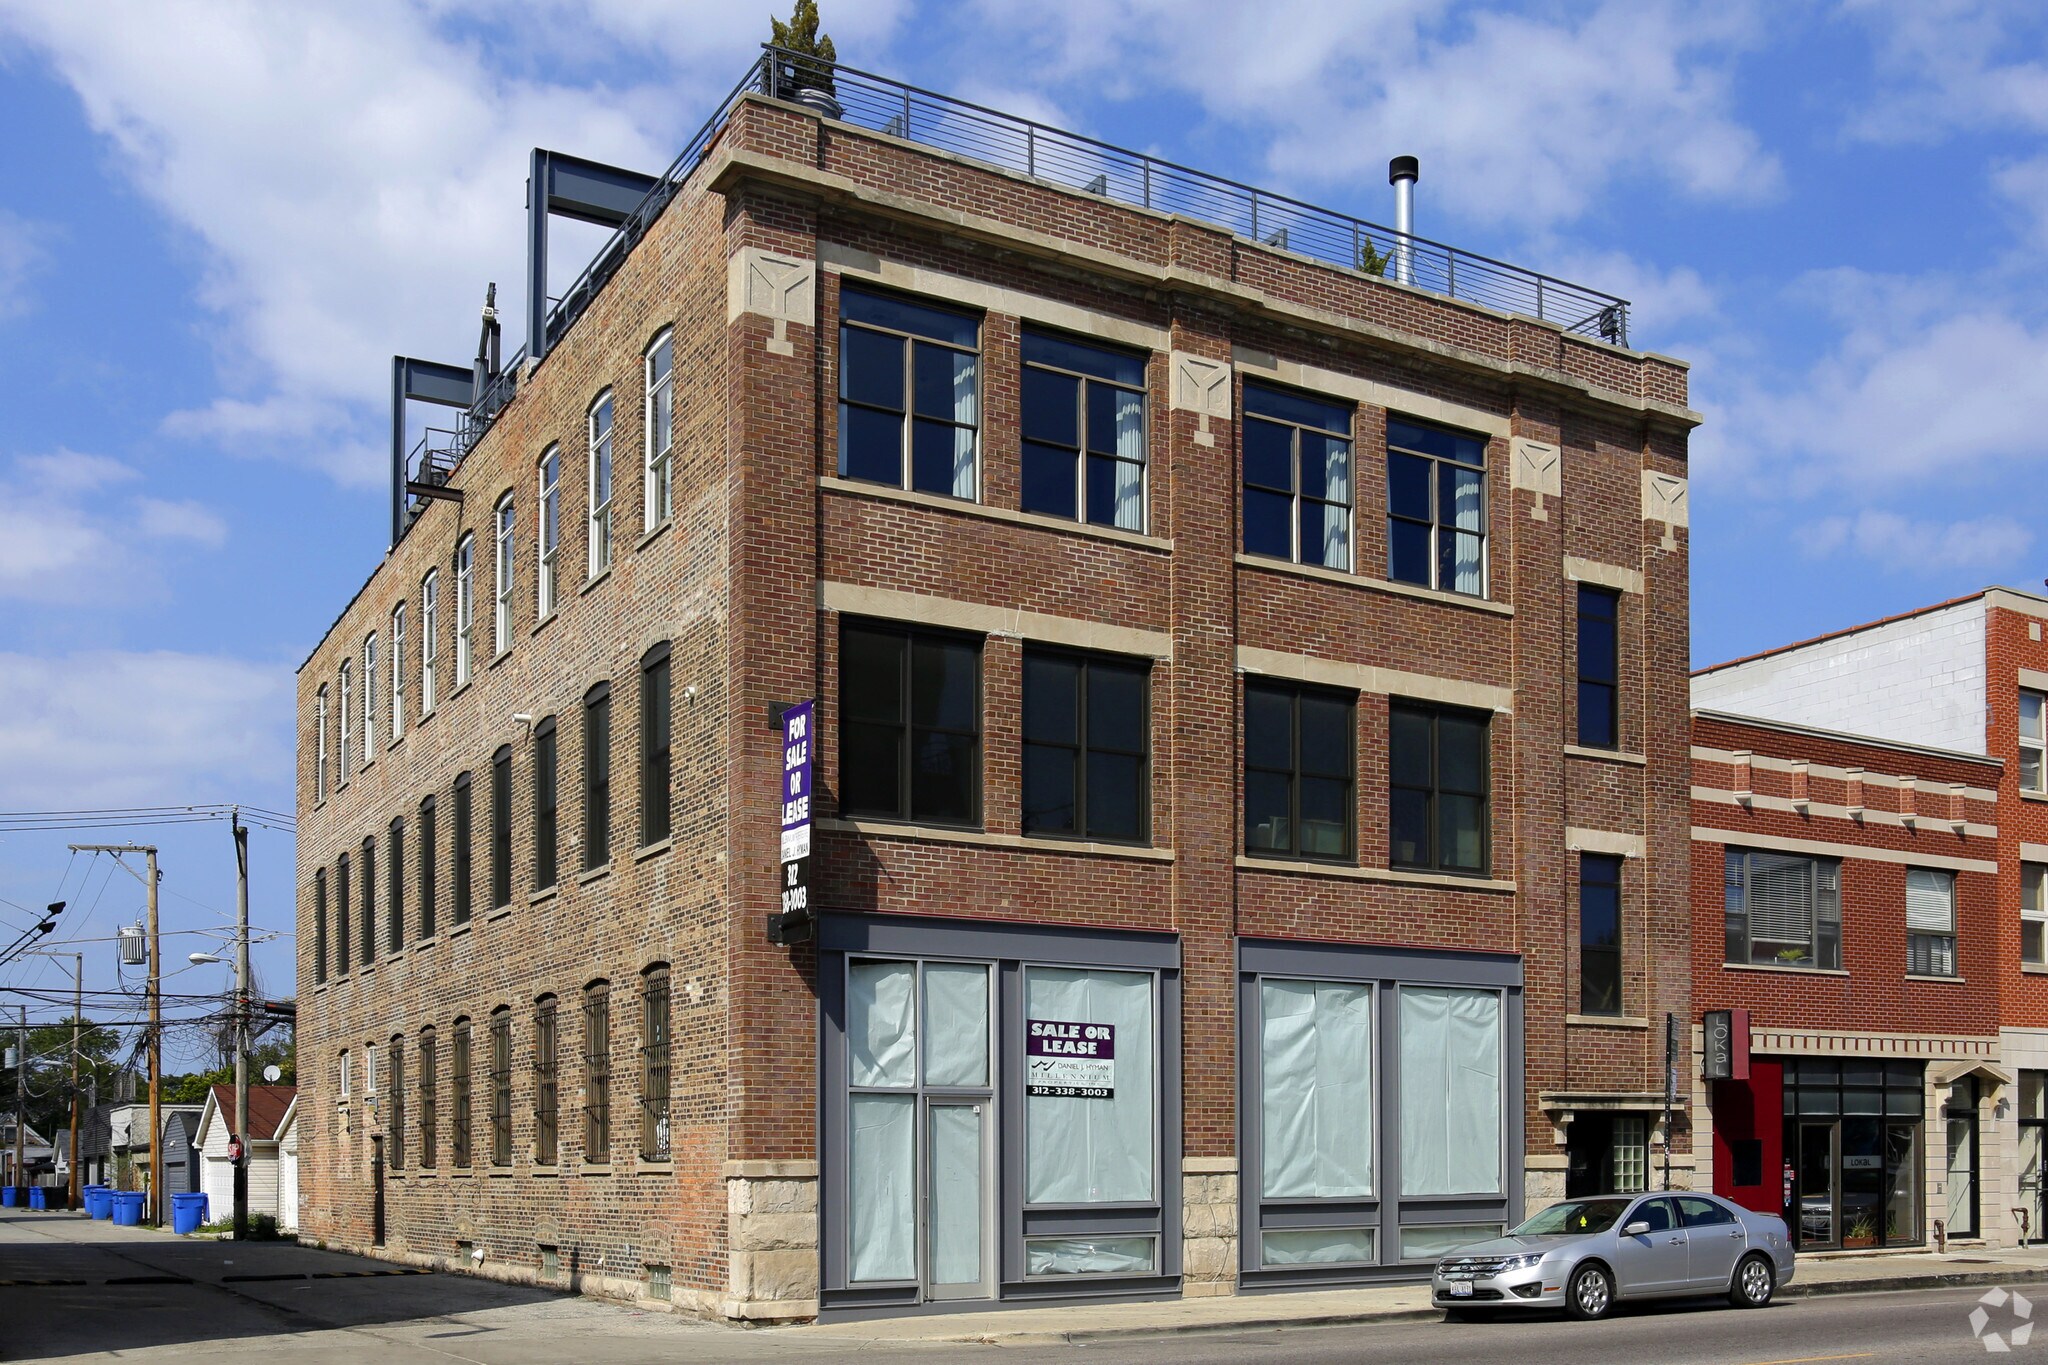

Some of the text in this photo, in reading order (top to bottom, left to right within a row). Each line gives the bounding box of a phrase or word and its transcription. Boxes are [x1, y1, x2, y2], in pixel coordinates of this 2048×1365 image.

[789, 714, 806, 742] FOR
[785, 740, 807, 771] SALE
[790, 771, 801, 796] OR
[782, 796, 808, 826] LEASE
[787, 863, 799, 887] 312
[1031, 1023, 1110, 1040] SALE OR
[1042, 1039, 1098, 1055] LEASE
[1031, 1072, 1109, 1080] MILLENNIUM
[1057, 1062, 1079, 1070] DANIEL
[1032, 1086, 1108, 1097] 312-338-3003
